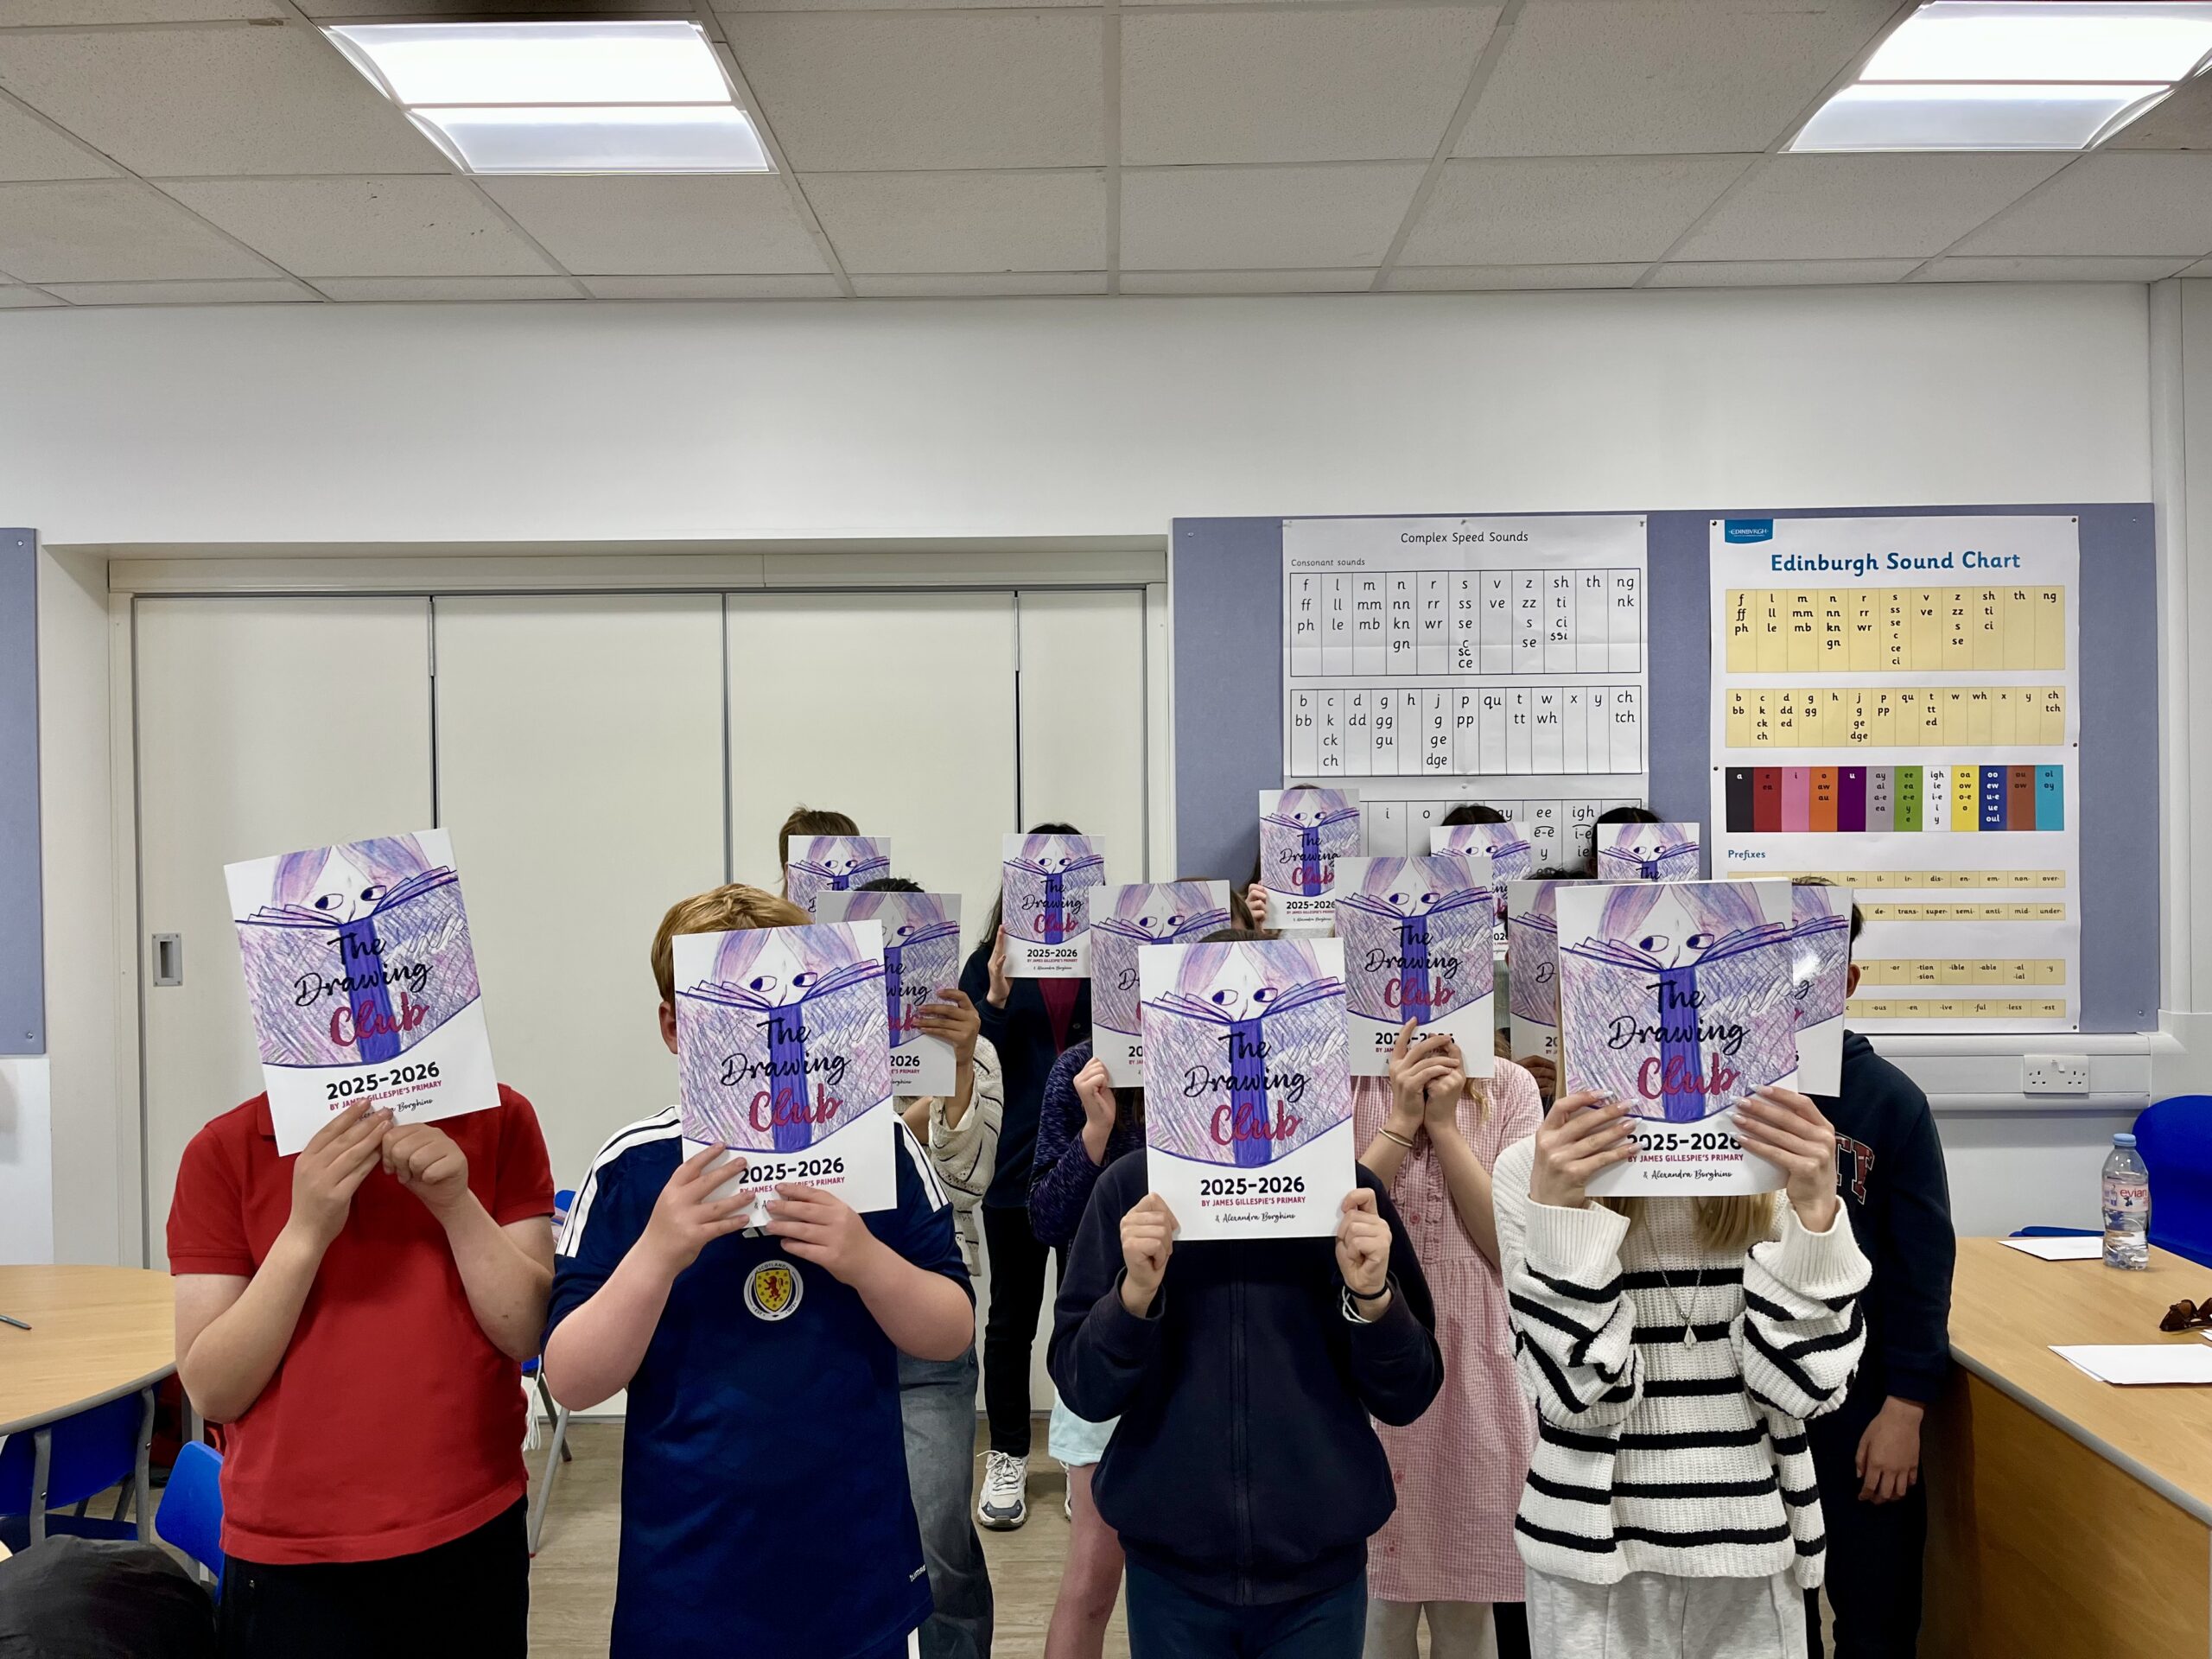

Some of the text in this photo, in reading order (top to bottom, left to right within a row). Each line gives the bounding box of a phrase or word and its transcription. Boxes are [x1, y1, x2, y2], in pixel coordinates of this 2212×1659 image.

[1401, 531, 1529, 545] Complex Speed Sounds
[1291, 557, 1365, 568] Consonant sounds
[1771, 551, 2020, 576] Edinburgh Sound Chart
[1554, 575, 1634, 590] sh th ng
[1301, 599, 1312, 611] ff
[1334, 598, 1342, 610] ll
[1357, 601, 1382, 610] mm
[1459, 601, 1471, 609] ss
[1490, 600, 1505, 608] ve
[1557, 596, 1566, 607] ti
[1618, 595, 1634, 607] nk
[1983, 590, 2056, 603] sh th ng
[1298, 619, 1314, 634] ph
[1332, 618, 1344, 630] le
[1359, 617, 1380, 630] mb
[1394, 617, 1410, 629] kn
[1425, 620, 1443, 629] wr
[1556, 616, 1567, 627] ci
[1735, 624, 1748, 634] ph
[1795, 622, 1811, 632] mb
[1393, 639, 1536, 652] gn se
[1827, 639, 1841, 650] gn
[1459, 659, 1472, 668] ce
[1484, 690, 1633, 709] qu ch
[1902, 695, 1914, 703] qu
[2046, 703, 2061, 712] tch
[1295, 709, 1635, 729] bb dd gg pp tt wh tch
[1324, 734, 1446, 748] ck gu ge
[1851, 731, 1868, 741] dge
[1323, 753, 1447, 766] ch dge
[1931, 772, 1944, 780] igh
[1536, 804, 1595, 821] ee igh
[1297, 833, 1323, 848] The
[1280, 848, 1341, 868] Drawing
[1578, 846, 1590, 857] ie
[1728, 849, 1766, 861] Prefixes
[1292, 865, 1334, 887] Club
[1040, 879, 1066, 894] The
[1021, 893, 1084, 914] Drawing
[1287, 900, 1336, 909] 2025-2026
[1034, 912, 1078, 933] Club
[1392, 925, 1433, 948] The
[327, 930, 387, 965] The
[1027, 949, 1077, 957] 2025-2026
[885, 956, 906, 975] he
[1365, 948, 1463, 979] Drawing
[294, 963, 434, 1007] Drawing
[887, 982, 931, 1006] wing
[1384, 976, 1455, 1008] Club
[1647, 980, 1707, 1014] The
[329, 991, 430, 1047] Club
[757, 1017, 811, 1051] The
[1608, 1016, 1751, 1055] Drawing
[1218, 1031, 1272, 1064] The
[720, 1052, 852, 1086] Drawing
[1637, 1052, 1742, 1100] Club
[326, 1061, 440, 1100] 2025-2026
[1184, 1065, 1311, 1103] Drawing
[367, 1087, 410, 1103] GILLESPIE'S
[411, 1080, 442, 1093] PRIMARY
[748, 1083, 843, 1132] Club
[1210, 1100, 1303, 1145] Club
[1627, 1132, 1742, 1151] 2025-2026
[739, 1157, 844, 1184] 2025-2026
[1651, 1169, 1692, 1179] Alexandra
[752, 1185, 772, 1193] JAMES
[817, 1177, 845, 1185] PRIMARY
[1201, 1176, 1305, 1195] 2025-2026
[2120, 1189, 2146, 1198] evian
[1236, 1197, 1274, 1205] GILLESPIE'S
[1223, 1212, 1260, 1223] Alexandra
